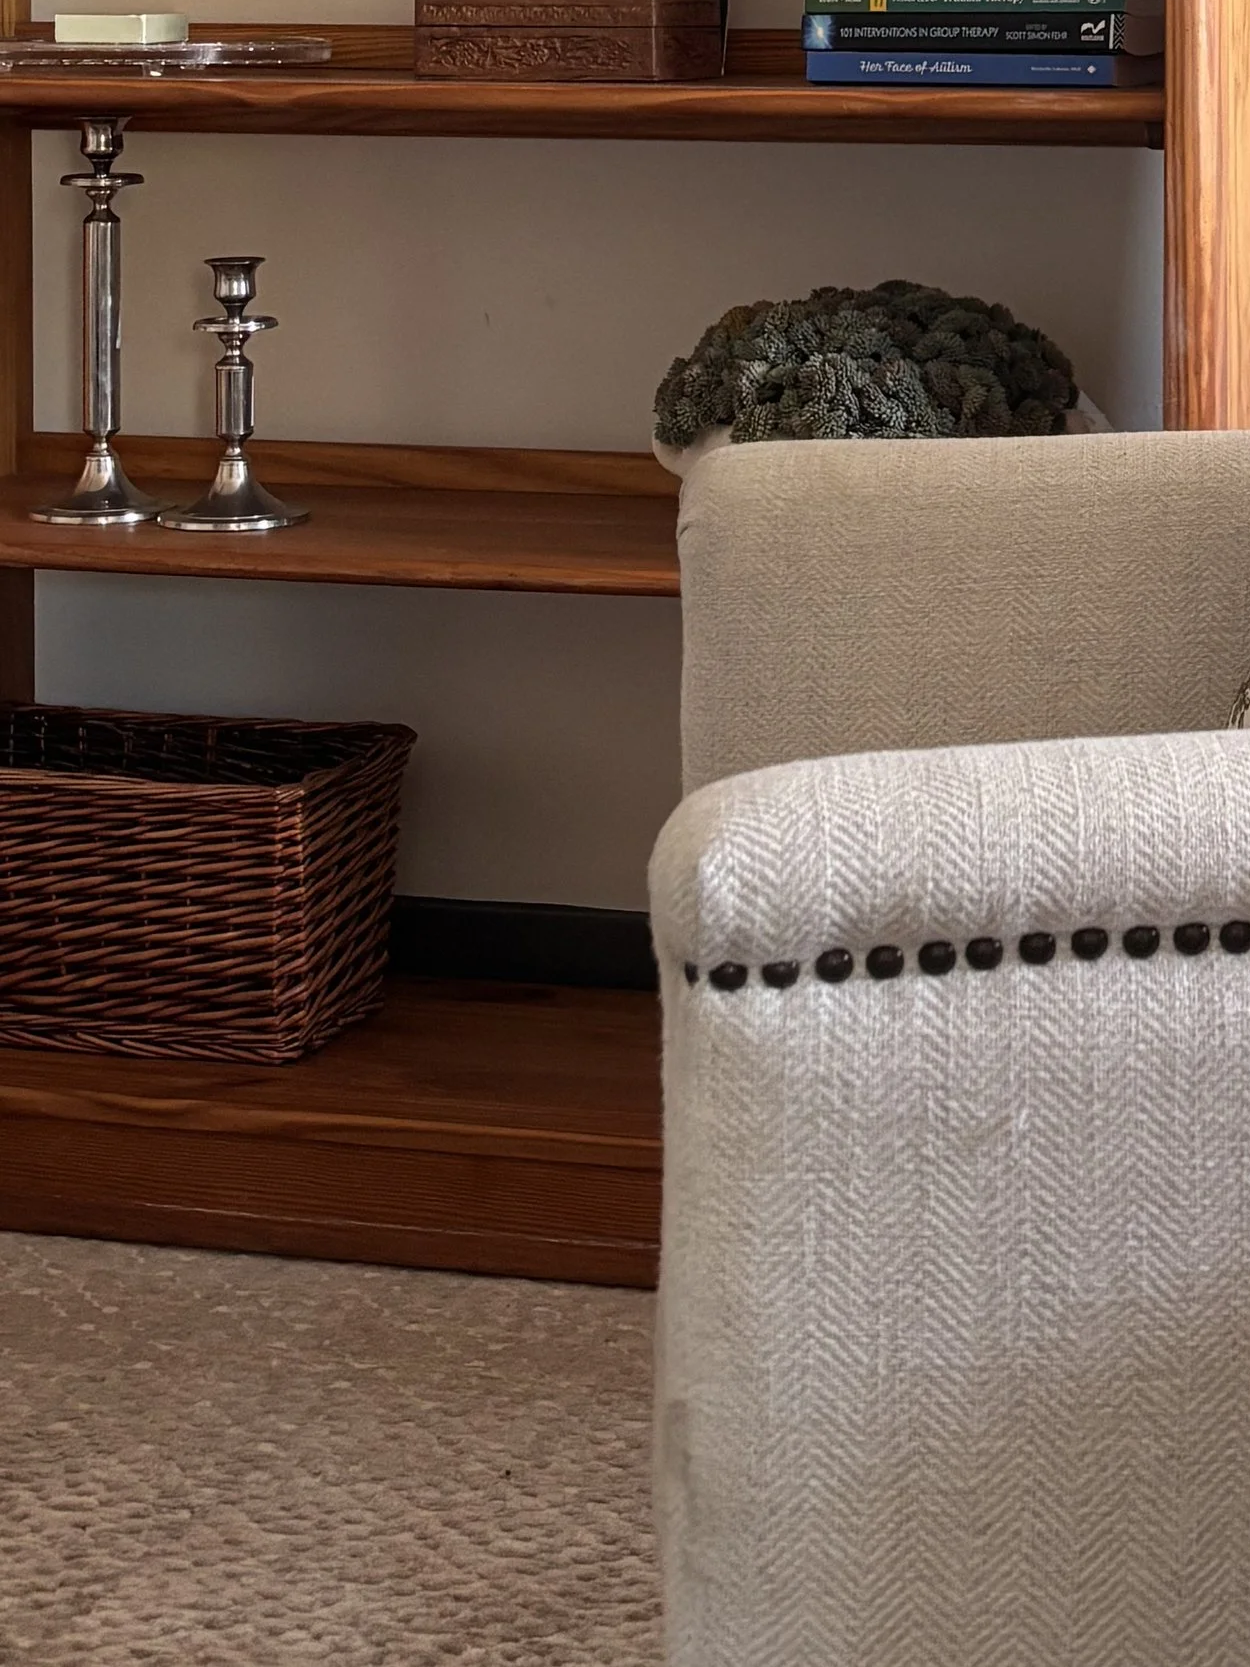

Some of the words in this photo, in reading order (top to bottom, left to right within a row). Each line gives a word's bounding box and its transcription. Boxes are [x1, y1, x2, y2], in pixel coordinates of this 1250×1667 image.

[840, 27, 853, 38] 101
[854, 27, 917, 38] INTERVENTIONS
[919, 27, 928, 37] IN
[929, 26, 960, 38] GROUP
[961, 26, 1000, 38] THERAPY
[1005, 31, 1026, 40] SCOTT
[859, 60, 884, 73] Her
[884, 60, 914, 72] Face
[915, 60, 928, 75] of
[928, 60, 973, 73] Autism
